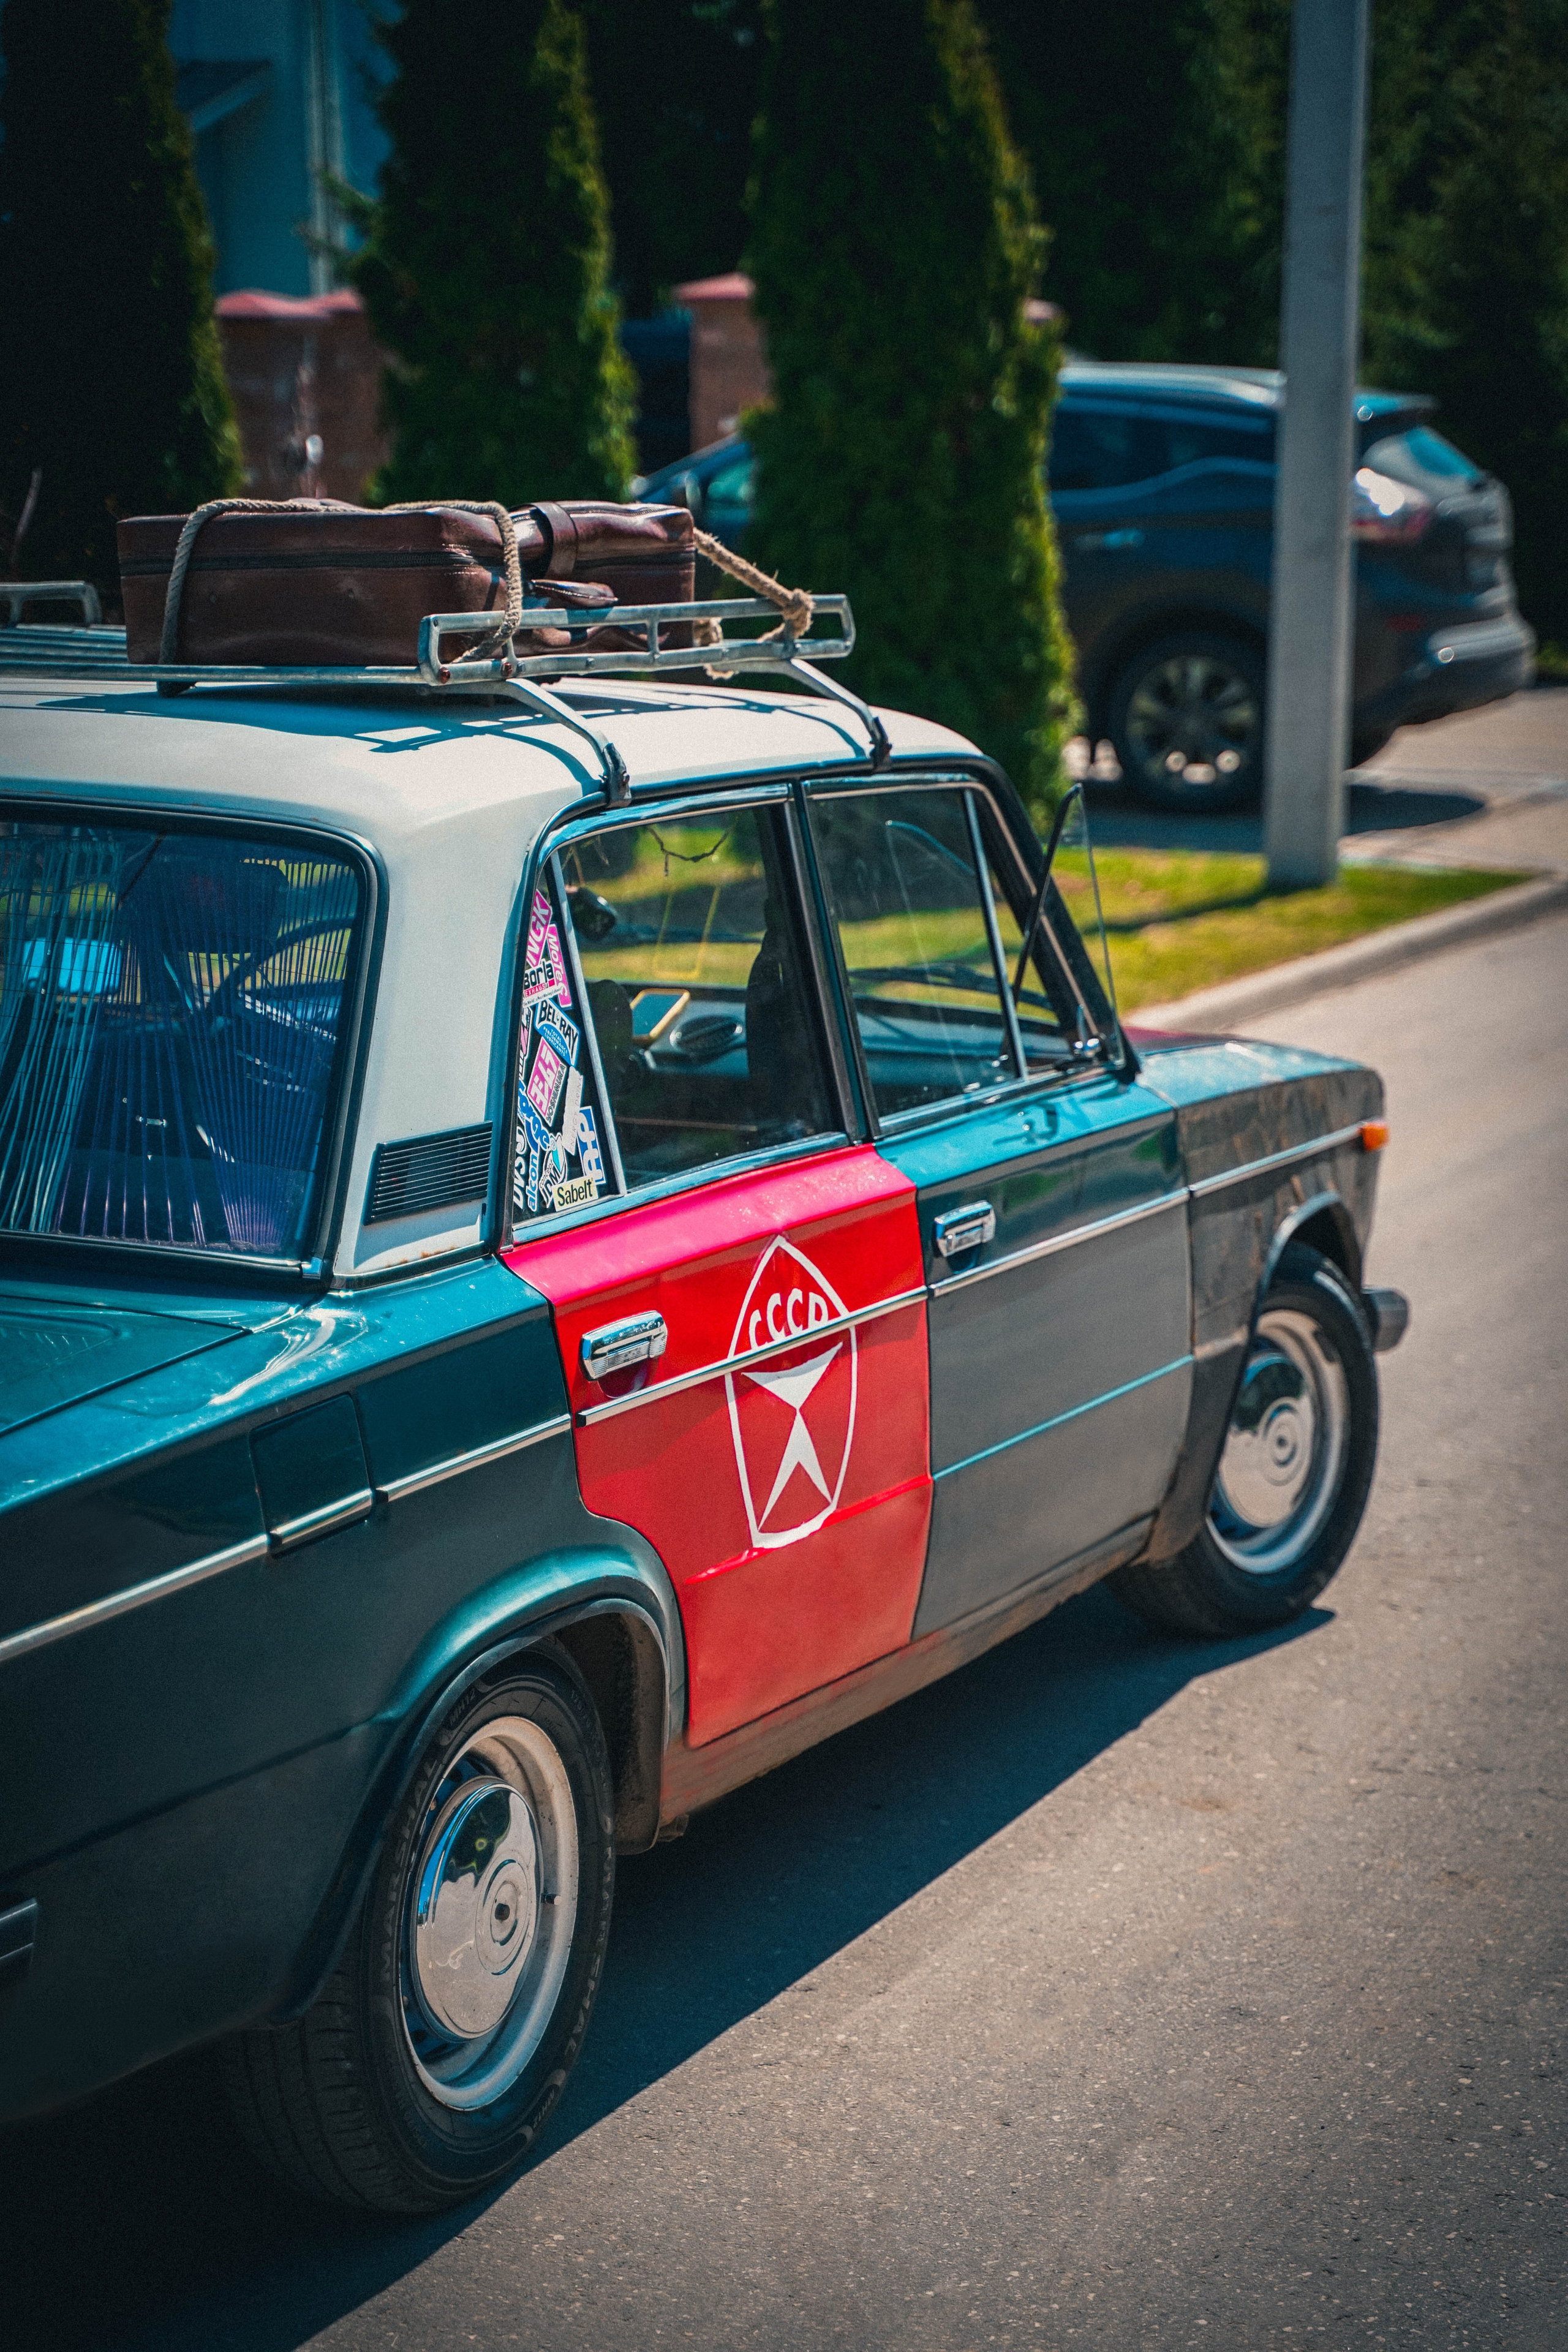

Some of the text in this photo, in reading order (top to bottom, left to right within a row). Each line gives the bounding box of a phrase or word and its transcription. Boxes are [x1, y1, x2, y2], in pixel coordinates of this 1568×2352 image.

[527, 895, 549, 966] NGK
[547, 933, 567, 997] MoTeC
[546, 1064, 566, 1124] YOSHIMURA
[568, 1112, 579, 1152] ENERGY
[527, 1154, 538, 1210] alcon
[540, 1159, 553, 1189] concept
[543, 1164, 562, 1205] JDM
[557, 1178, 592, 1207] Sabelt
